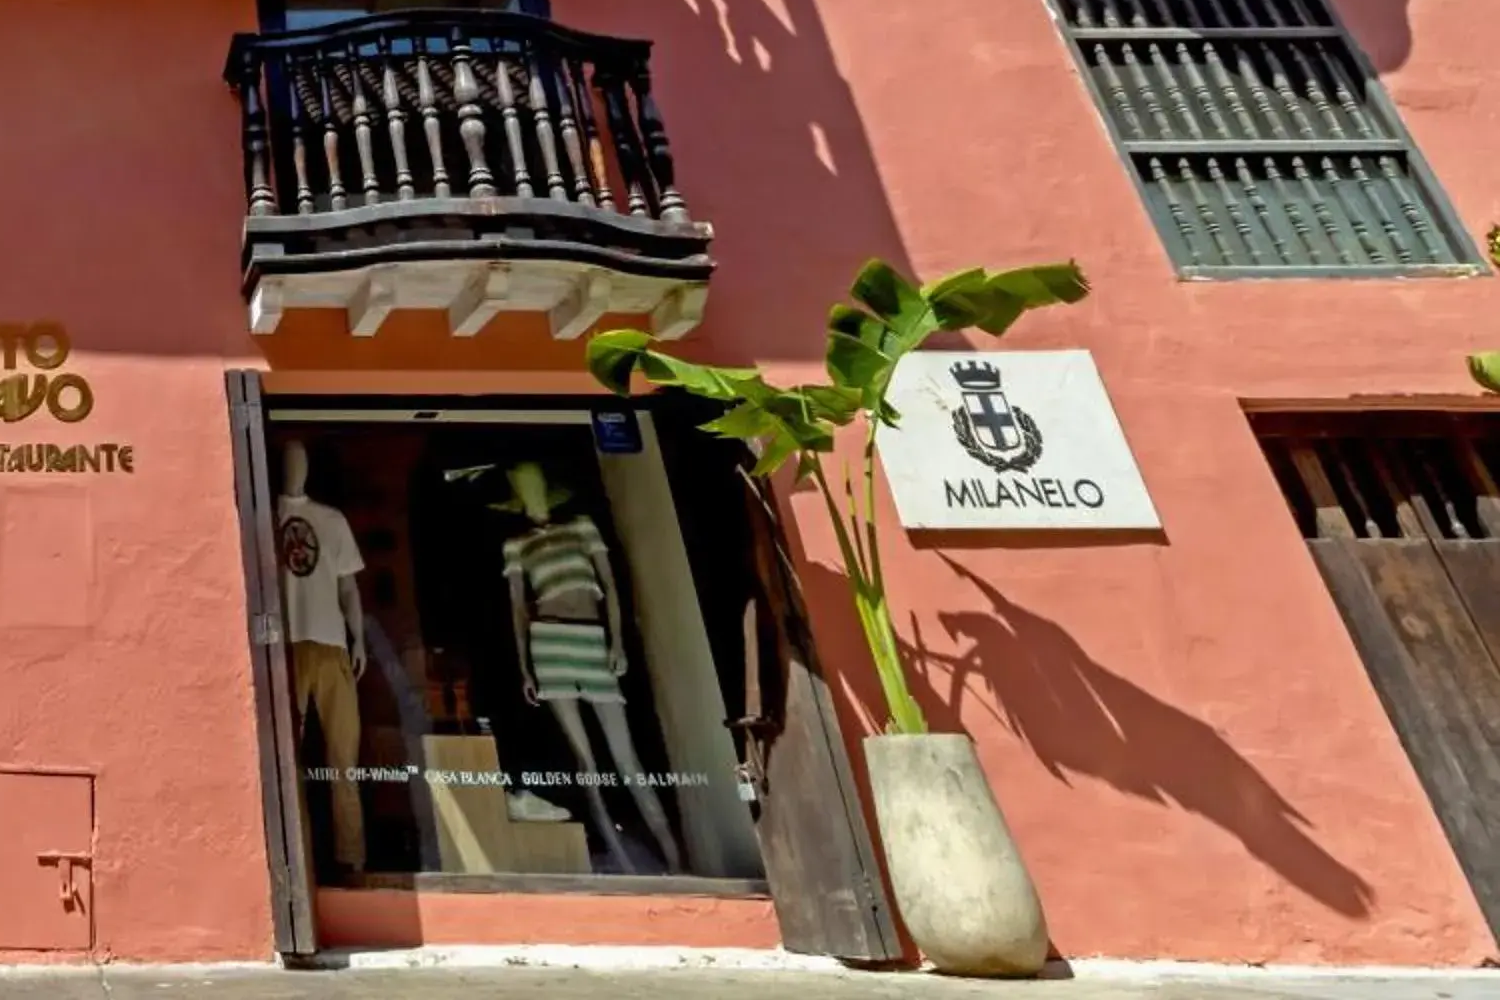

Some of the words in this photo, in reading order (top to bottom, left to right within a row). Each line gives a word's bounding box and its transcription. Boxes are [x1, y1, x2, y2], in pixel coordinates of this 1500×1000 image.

[943, 478, 1104, 509] MILANELO
[521, 771, 571, 785] GOLDEN
[576, 772, 618, 786] GOOSE
[636, 772, 709, 787] BALMAIN
